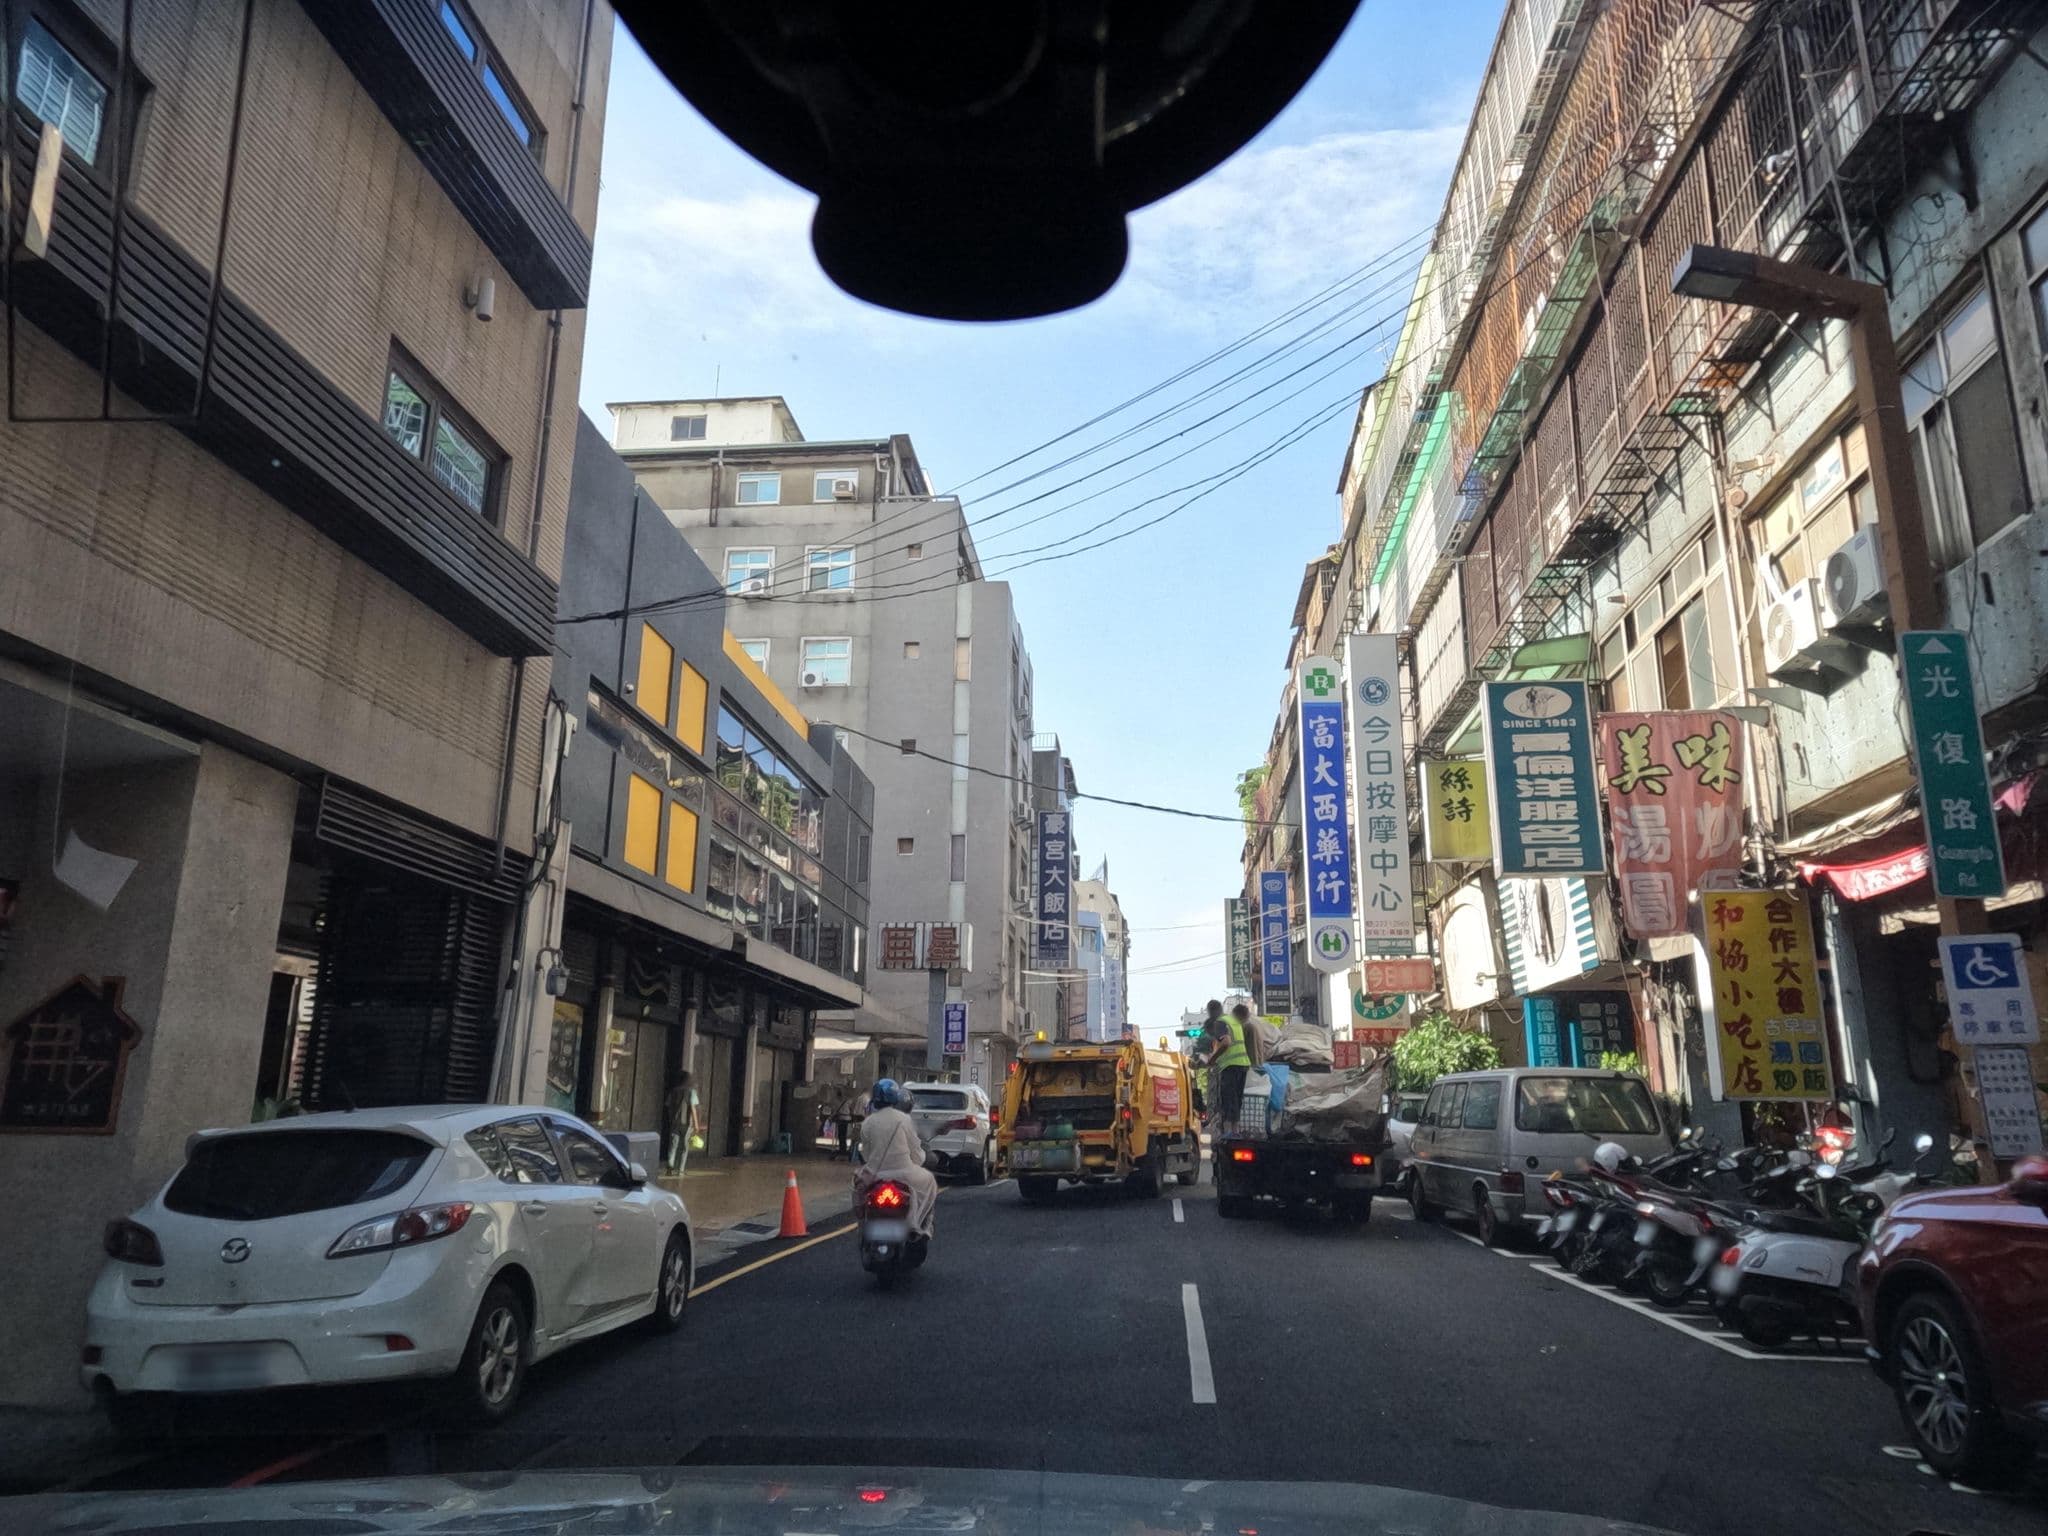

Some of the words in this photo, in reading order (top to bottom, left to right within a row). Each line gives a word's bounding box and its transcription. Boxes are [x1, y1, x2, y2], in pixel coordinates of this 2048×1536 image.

[1440, 767, 1475, 823] 絲詩
[1502, 719, 1541, 729] SINCE
[1610, 721, 1741, 795] 美味
[1921, 665, 1978, 831] 光復路
[1044, 814, 1066, 940] 豪宮大飯店
[1309, 715, 1345, 905] 富大西藥行
[1362, 716, 1402, 911] 今日按摩中心
[1713, 898, 1762, 1093] 和協小吃店
